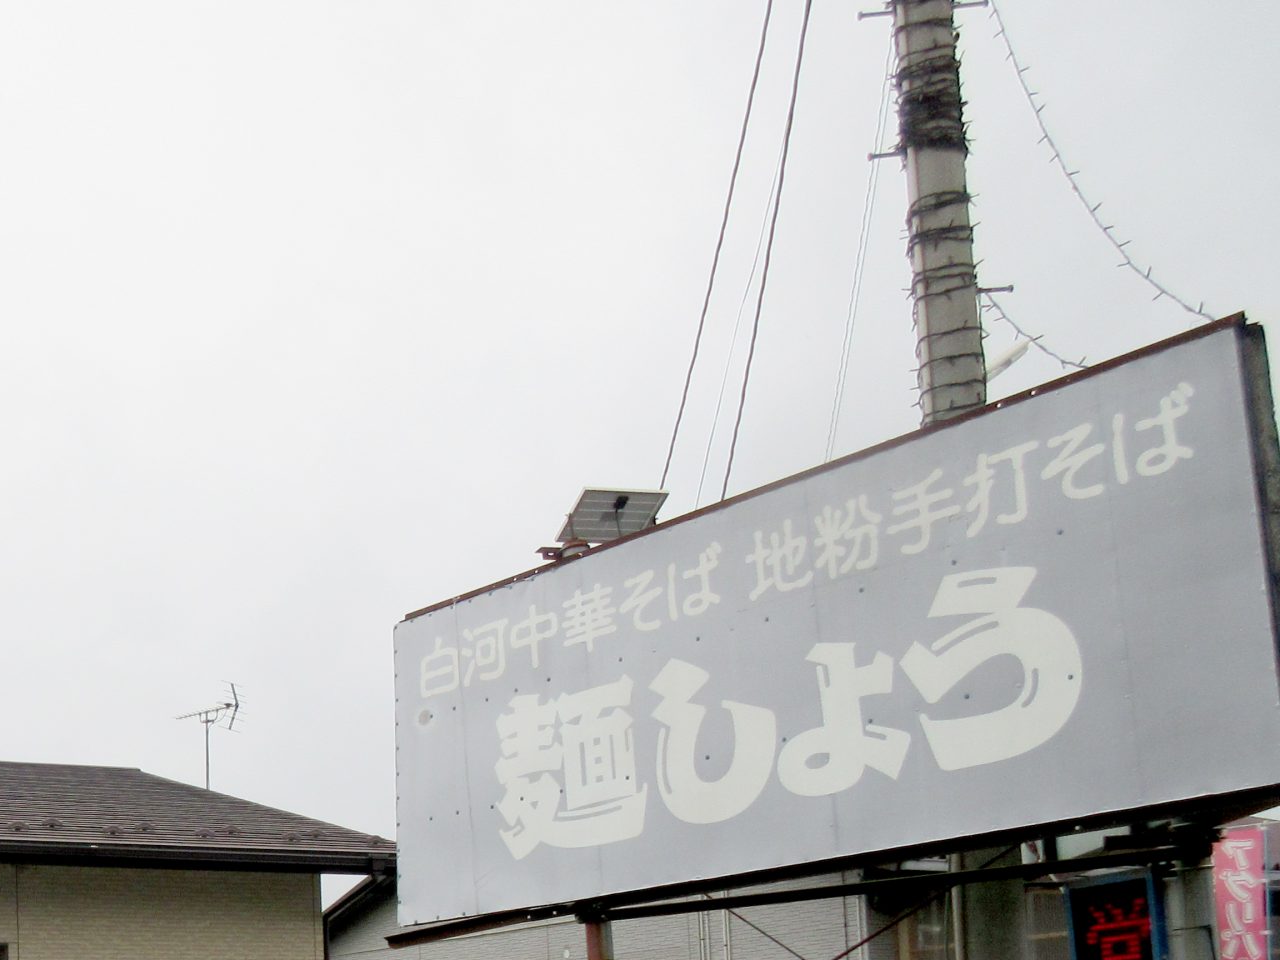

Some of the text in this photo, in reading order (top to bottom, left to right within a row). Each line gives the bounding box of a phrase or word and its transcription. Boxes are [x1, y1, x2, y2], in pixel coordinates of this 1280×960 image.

[420, 382, 1195, 697] 白河中華そば 地粉手打そば
[494, 565, 1083, 861] 麺しょう
